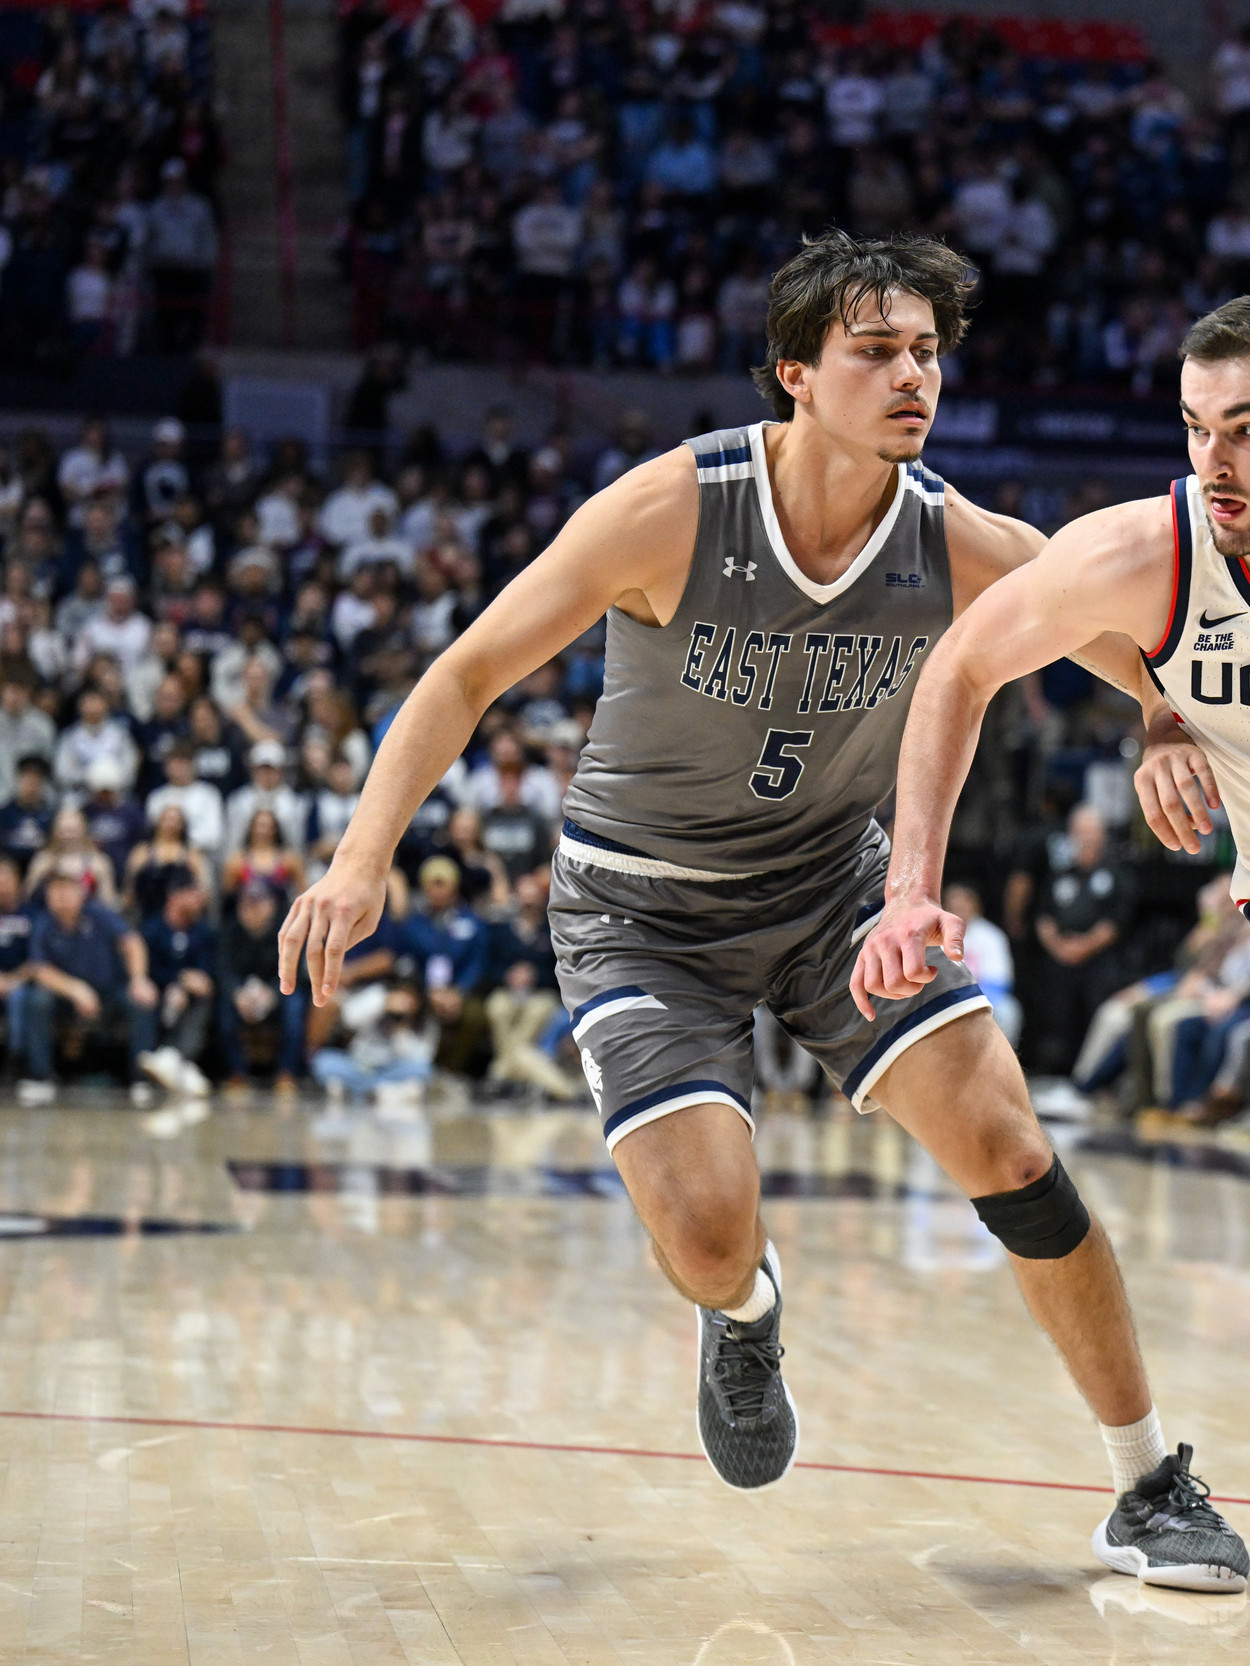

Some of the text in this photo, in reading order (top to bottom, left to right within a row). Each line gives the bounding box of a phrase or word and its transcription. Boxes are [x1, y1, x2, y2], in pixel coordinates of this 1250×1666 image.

[1193, 641, 1234, 651] CHANGE
[1198, 632, 1233, 642] BE THE
[680, 621, 928, 714] EAST TEXAS
[748, 728, 814, 801] 5
